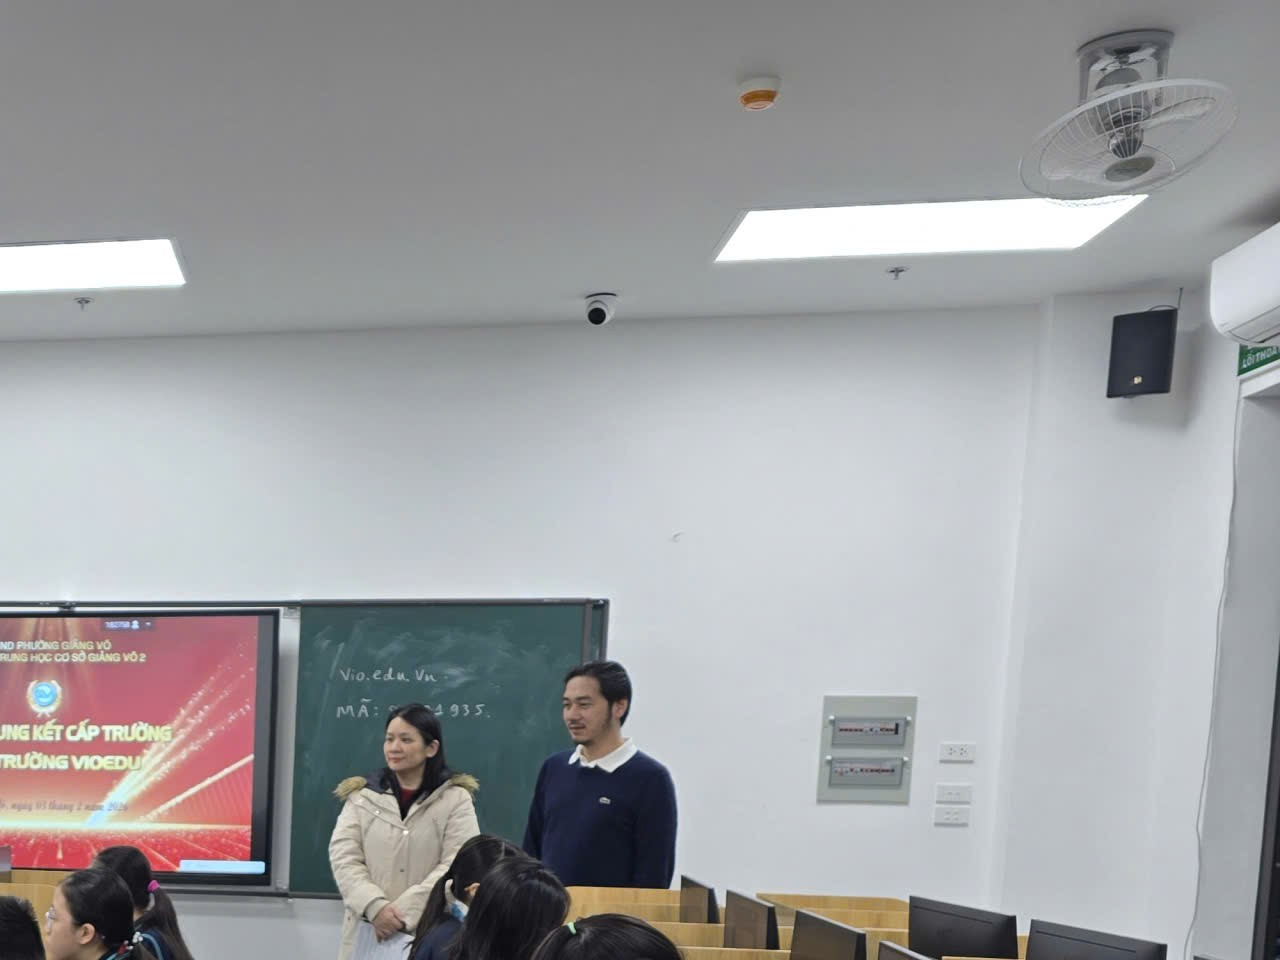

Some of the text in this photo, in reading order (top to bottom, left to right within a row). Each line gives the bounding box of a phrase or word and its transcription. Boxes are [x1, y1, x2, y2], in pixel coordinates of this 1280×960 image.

[30, 652, 53, 664] HỌC
[87, 650, 121, 663] GIẢNG
[139, 653, 147, 663] 2
[32, 718, 64, 741] KẾT
[65, 718, 100, 741] CẤP
[101, 720, 172, 742] TRƯỜNG
[71, 754, 141, 771] VIOEDU
